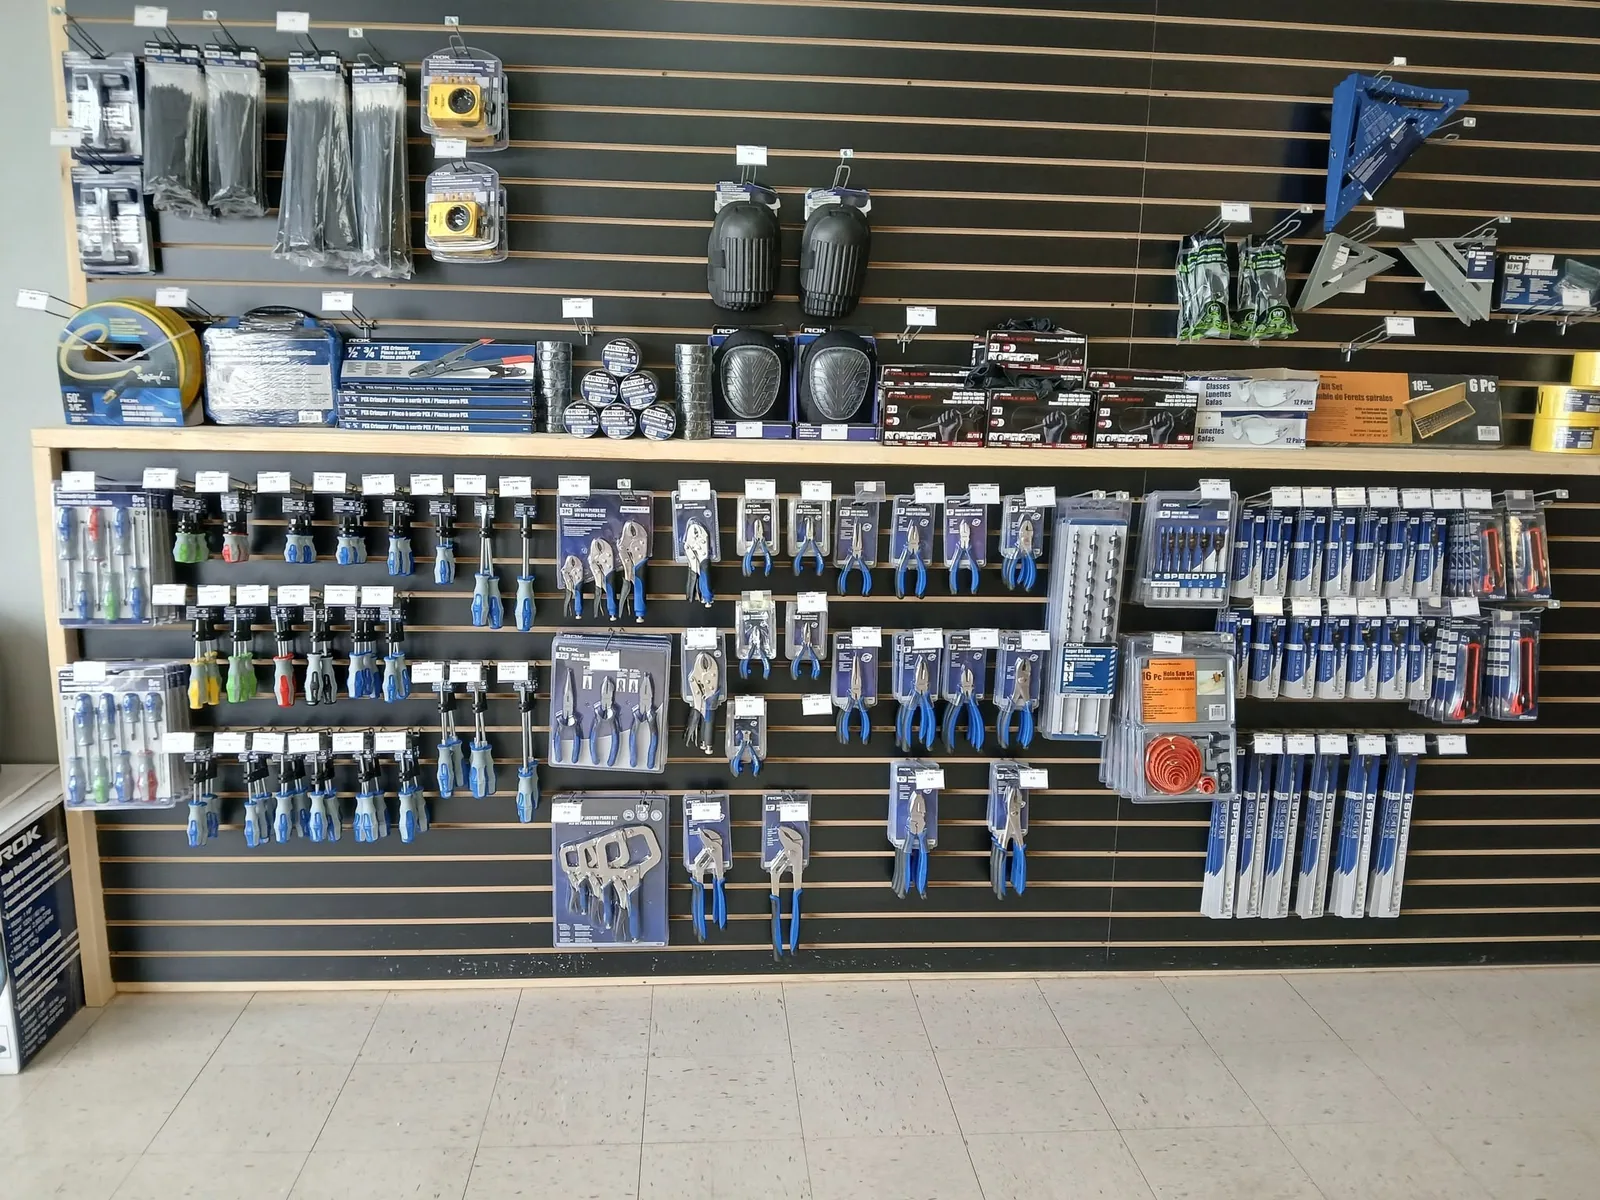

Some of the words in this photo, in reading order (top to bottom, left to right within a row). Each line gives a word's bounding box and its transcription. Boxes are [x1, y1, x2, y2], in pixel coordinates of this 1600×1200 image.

[1412, 380, 1423, 391] 18
[1469, 379, 1478, 392] 6
[1480, 379, 1496, 393] Pc
[1142, 672, 1152, 680] 16
[0, 825, 42, 867] ROK
[1230, 803, 1240, 861] SPEEDTIP
[1363, 802, 1374, 861] SPEEDTIP
[1400, 802, 1411, 861] SPEEDTIP
